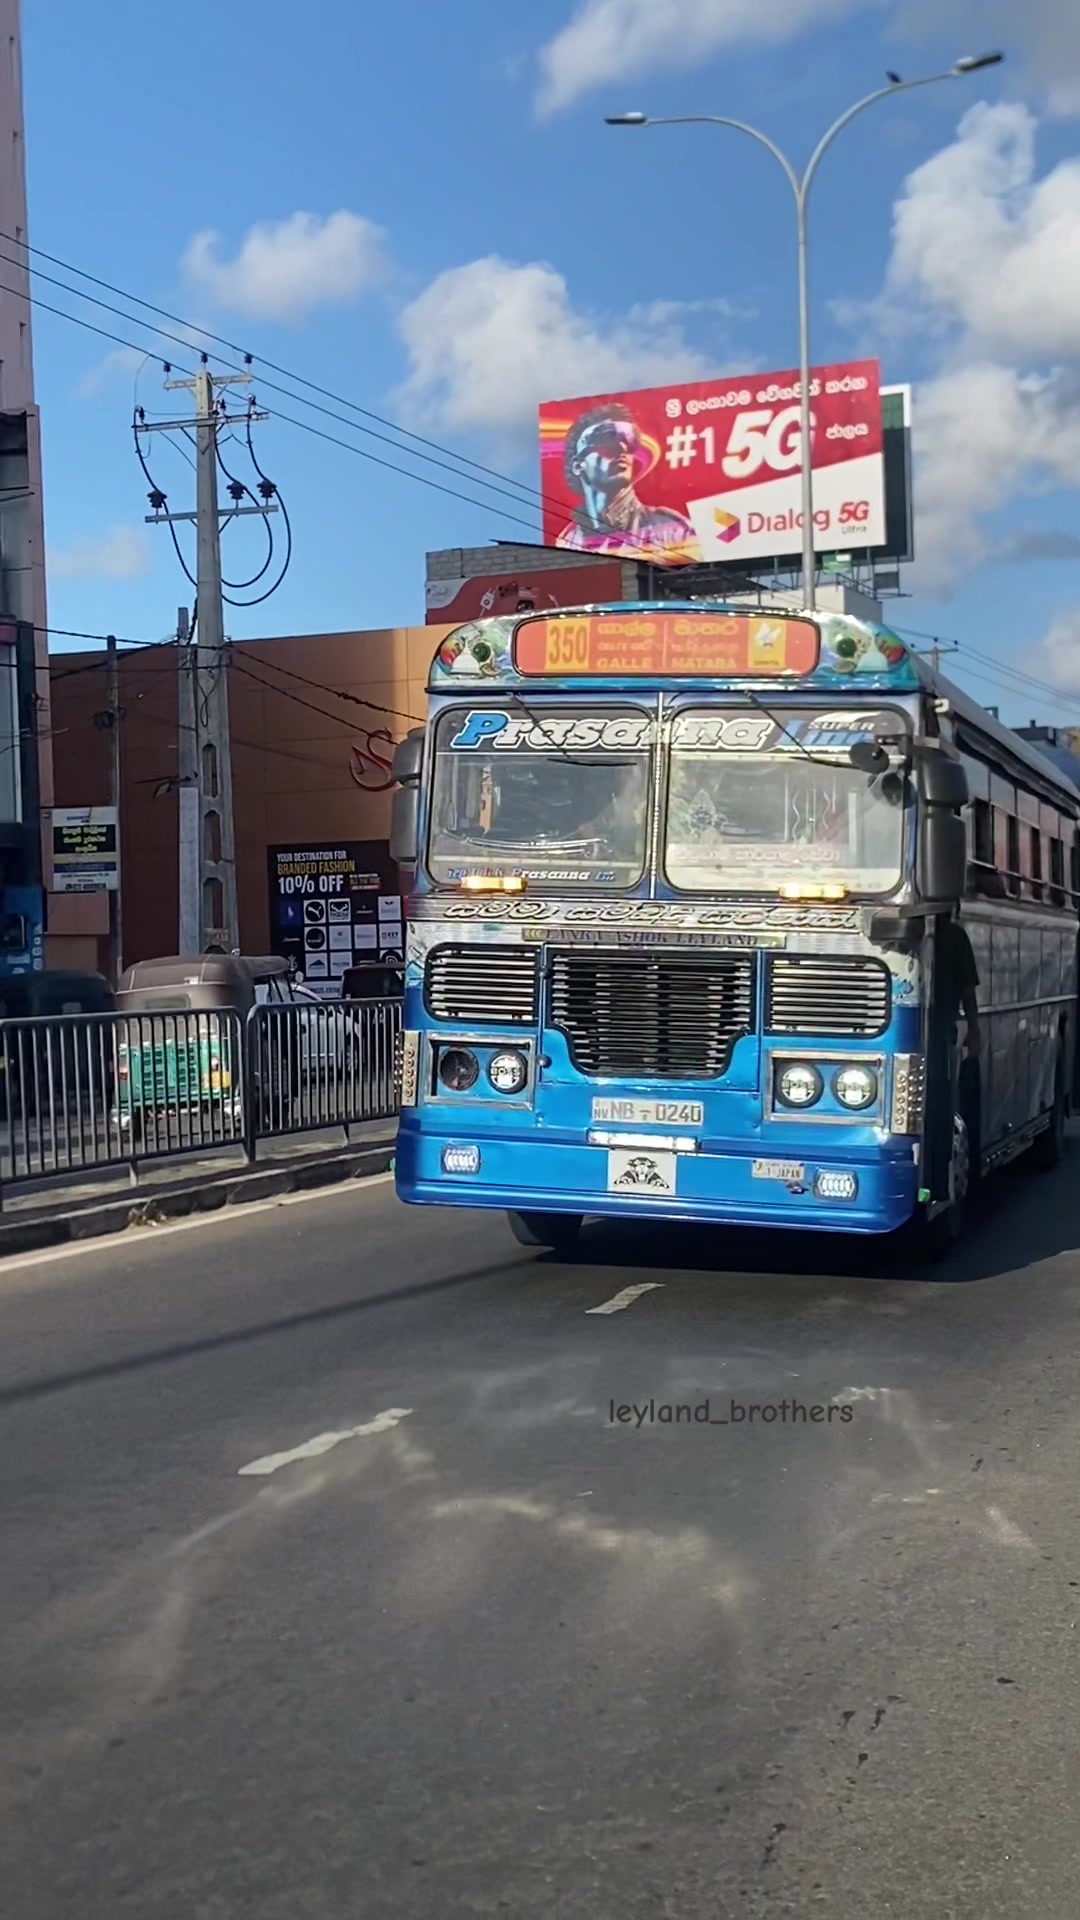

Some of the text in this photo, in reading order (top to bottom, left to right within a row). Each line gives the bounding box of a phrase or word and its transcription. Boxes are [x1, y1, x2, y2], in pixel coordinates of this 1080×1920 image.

[665, 425, 714, 469] #1
[722, 406, 816, 479] 5G
[838, 501, 870, 524] 5G
[550, 625, 588, 665] 350
[597, 657, 652, 669] GALLE
[277, 850, 347, 862] YOUR DESTINATION FOR
[278, 860, 355, 875] BRANDED FASHION
[279, 874, 344, 894] 10% OFF
